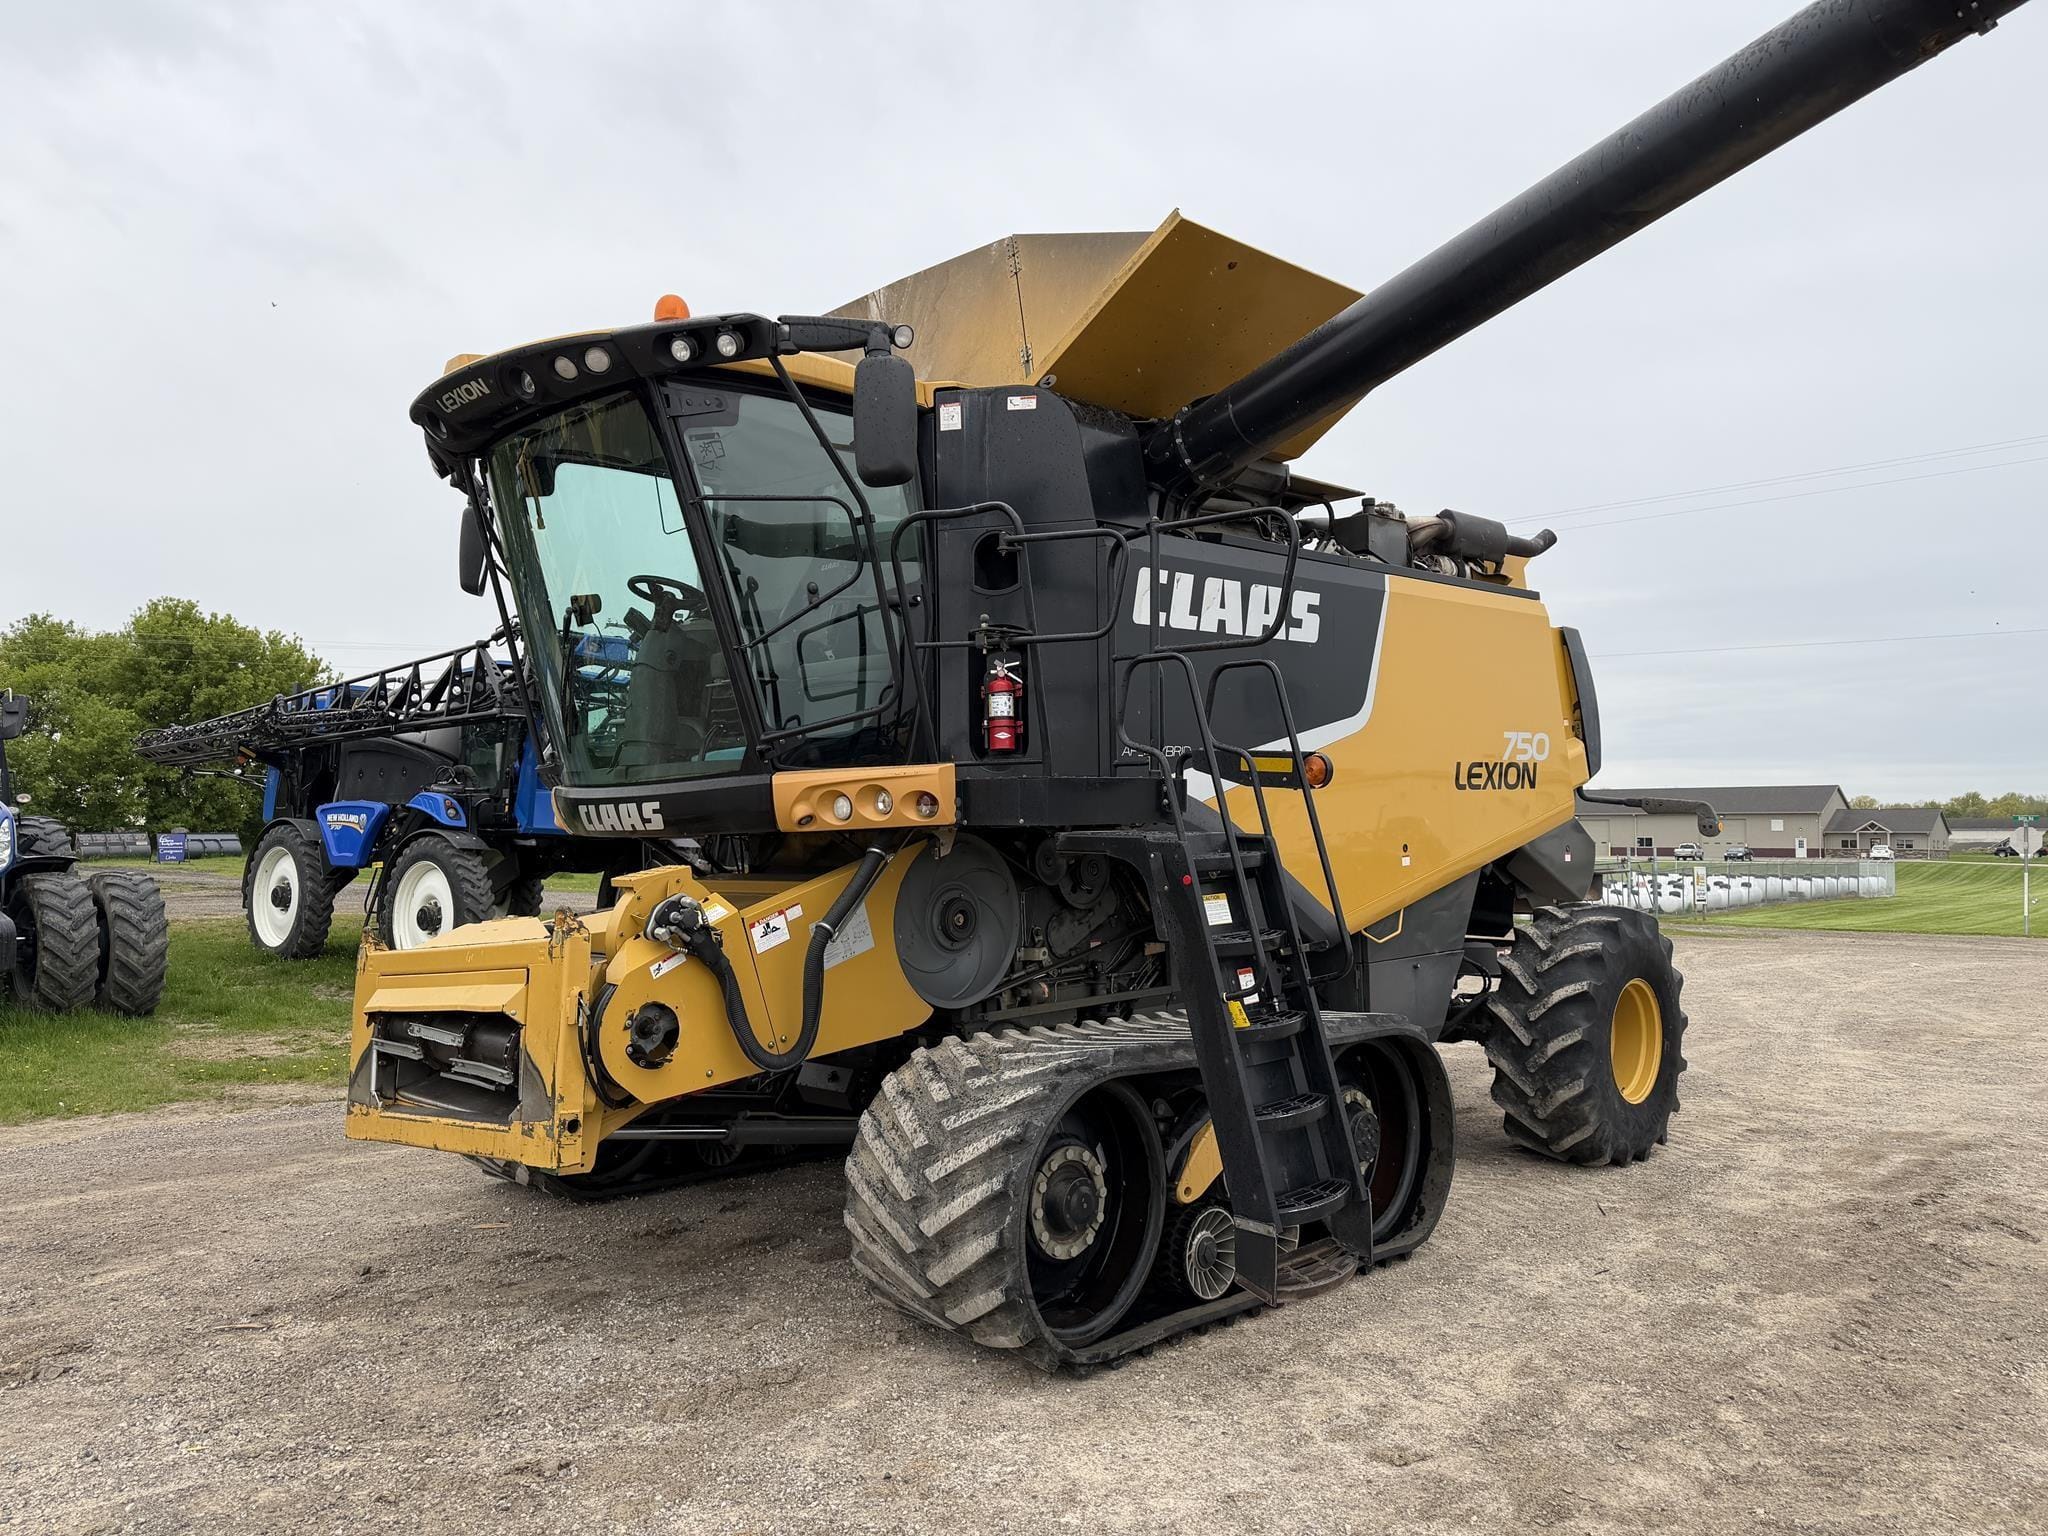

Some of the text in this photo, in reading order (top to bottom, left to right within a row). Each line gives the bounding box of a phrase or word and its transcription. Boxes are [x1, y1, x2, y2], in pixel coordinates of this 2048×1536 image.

[436, 378, 490, 413] LEXION
[1132, 567, 1321, 644] CLAAS
[1503, 731, 1550, 761] 750
[1455, 761, 1537, 790] LEXION
[578, 801, 664, 831] CLAAS
